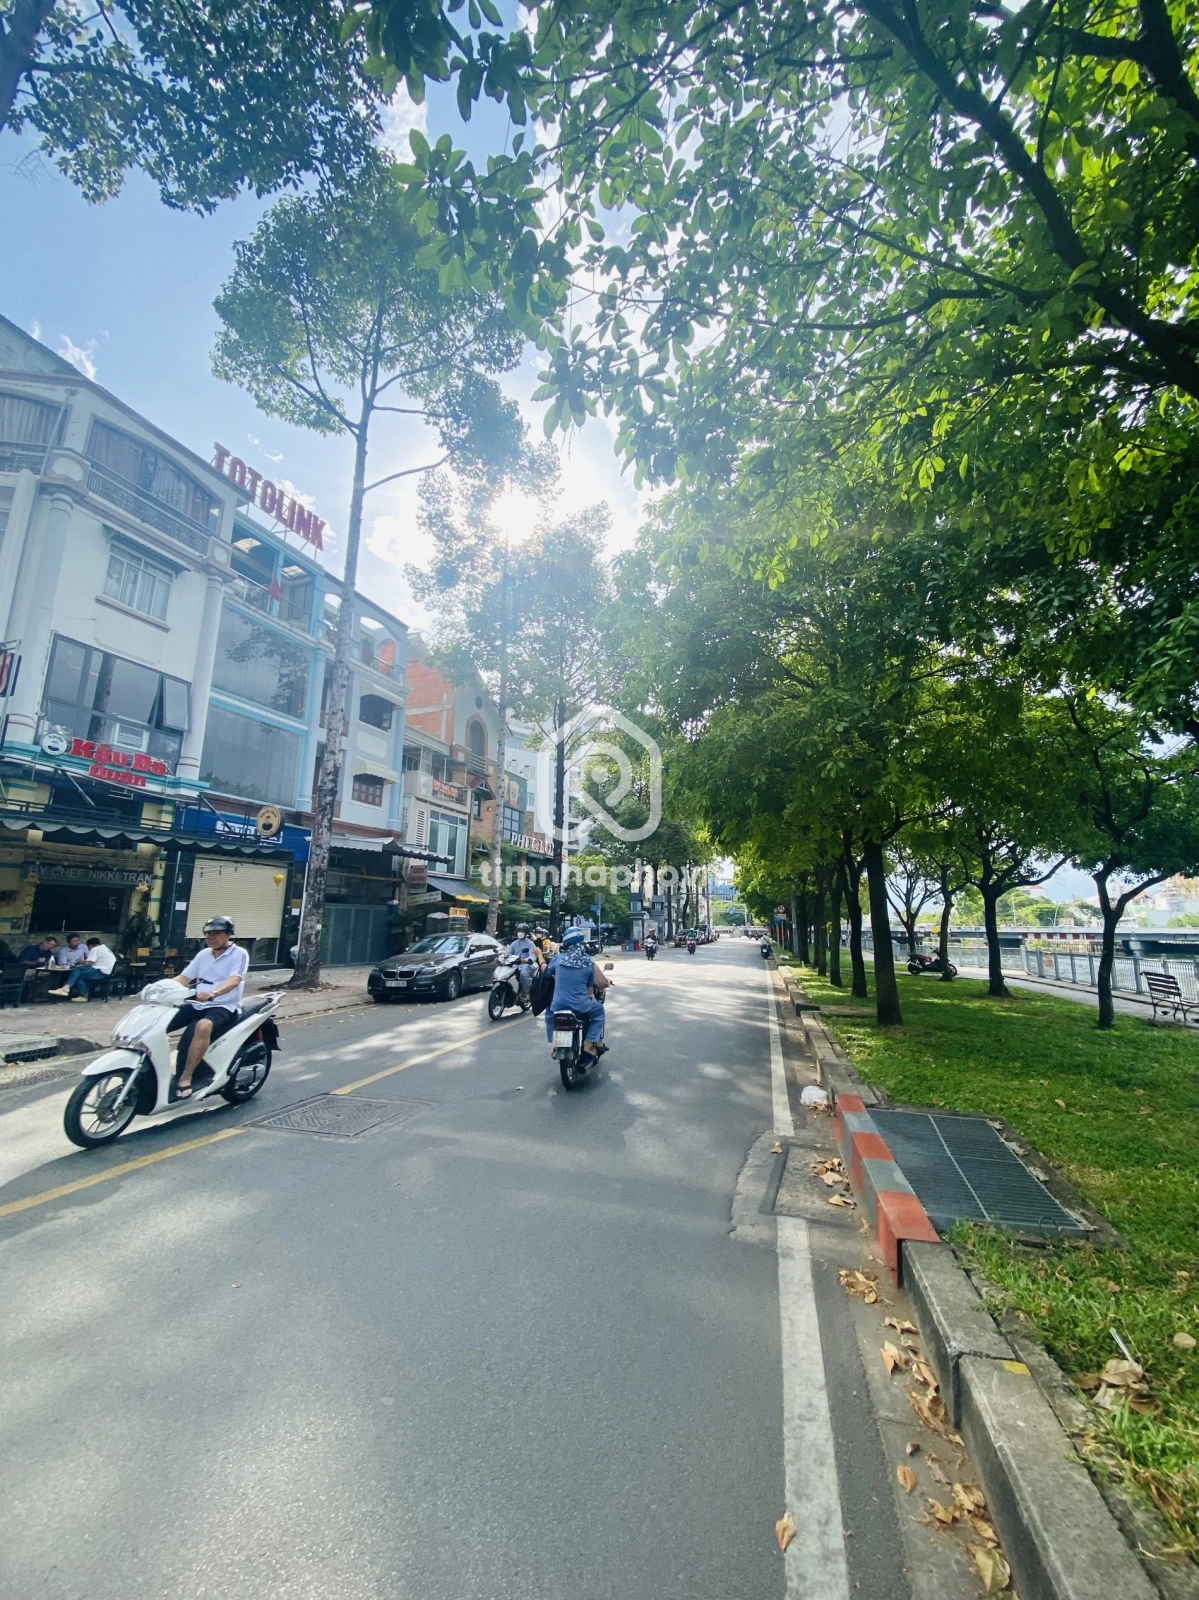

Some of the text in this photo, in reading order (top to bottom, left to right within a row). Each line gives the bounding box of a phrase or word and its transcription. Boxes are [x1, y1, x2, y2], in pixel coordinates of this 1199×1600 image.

[213, 441, 327, 551] TOTOLINK
[131, 752, 168, 775] Ba
[29, 864, 153, 882] BY CHEF NIKKI TRAN
